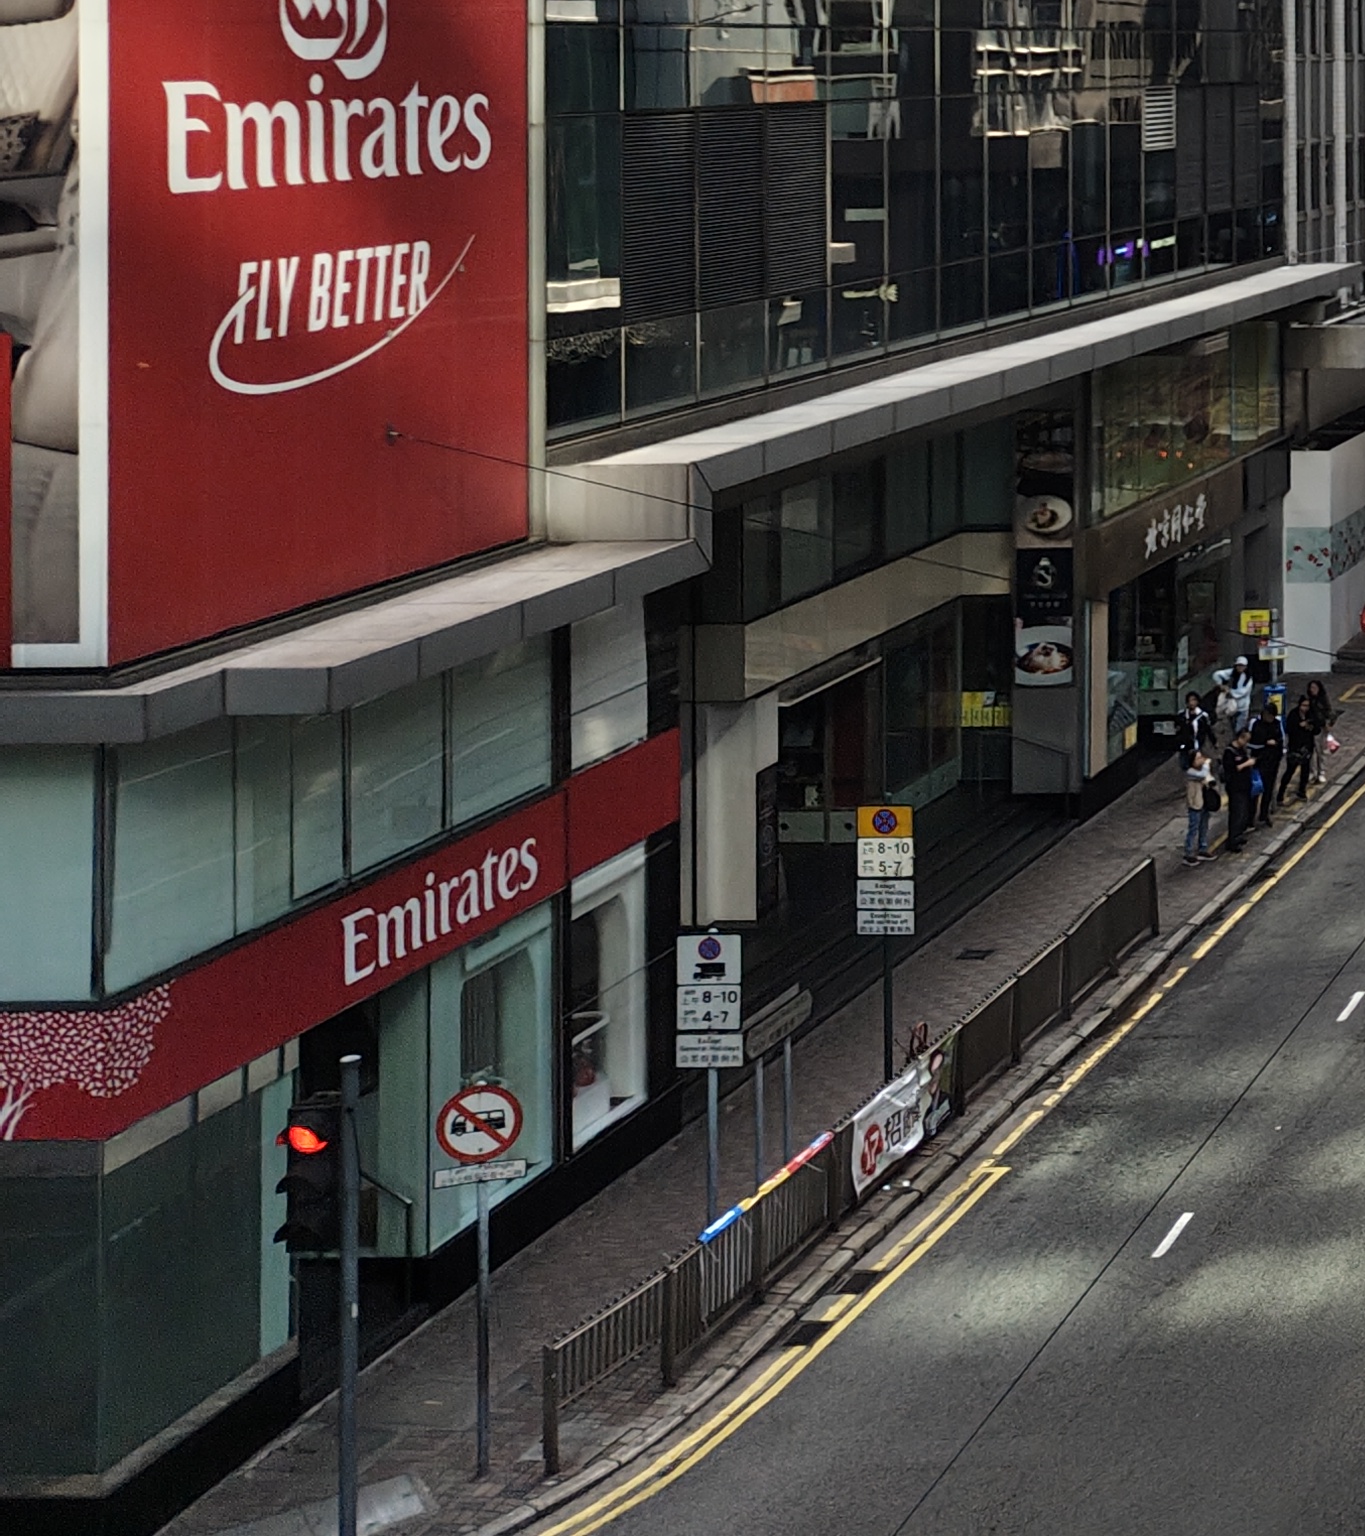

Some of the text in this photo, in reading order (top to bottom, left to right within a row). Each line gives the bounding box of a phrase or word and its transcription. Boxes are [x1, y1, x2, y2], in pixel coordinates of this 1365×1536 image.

[161, 73, 492, 195] Emirates
[234, 240, 432, 345] FLY BETTER
[340, 836, 540, 987] Emirates
[702, 990, 738, 1004] 8-10
[702, 1010, 729, 1023] 4-7
